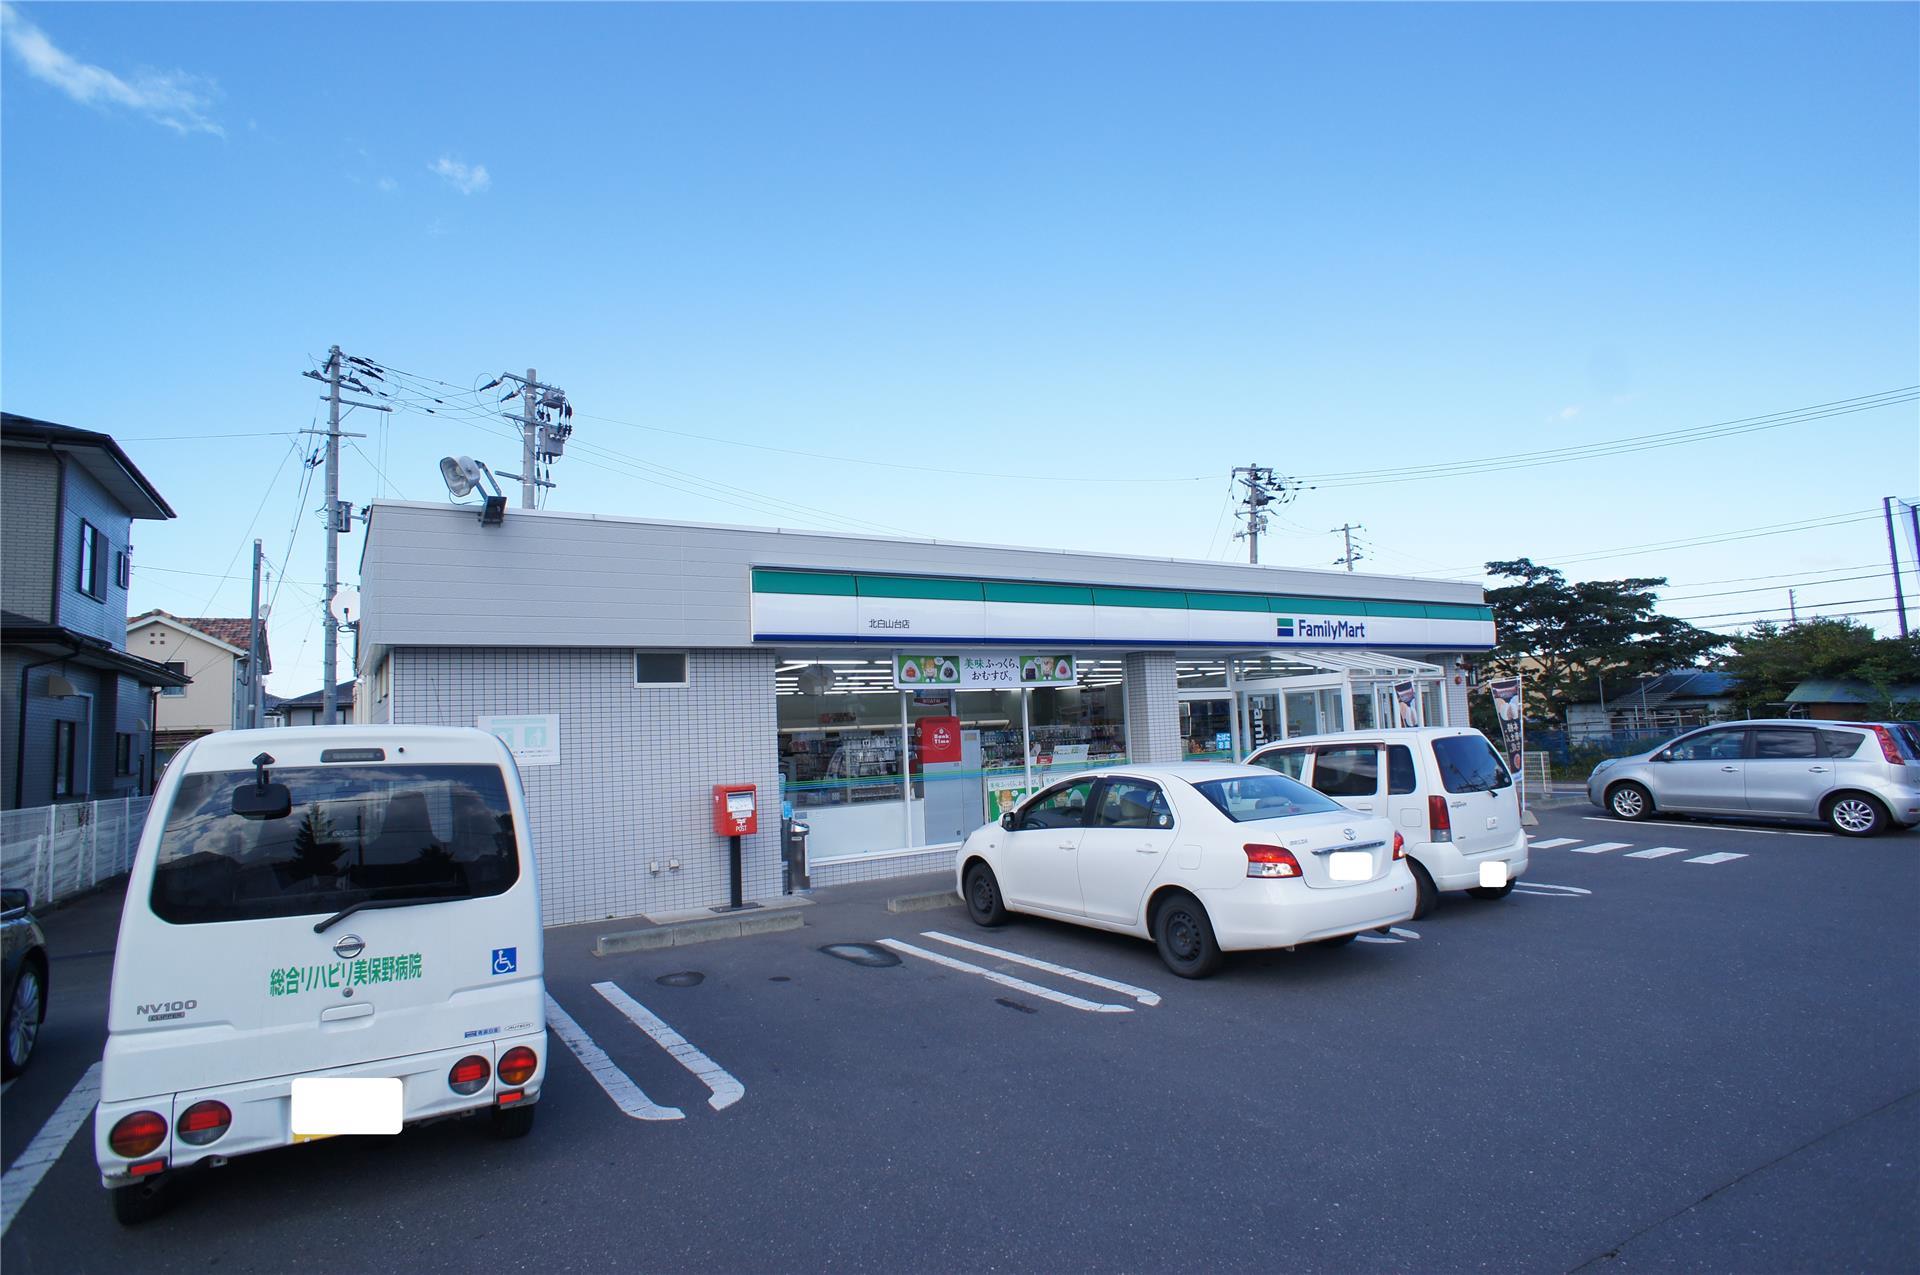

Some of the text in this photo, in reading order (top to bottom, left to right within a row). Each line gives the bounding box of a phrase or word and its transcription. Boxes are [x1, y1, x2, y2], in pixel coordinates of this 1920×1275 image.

[869, 618, 910, 629] 北白山台店
[1298, 619, 1365, 640] FamilyMart
[971, 670, 1013, 681] おむすび。
[736, 824, 747, 832] POST
[270, 952, 422, 996] 総合リハビリ美保野病院
[136, 999, 198, 1015] NV100
